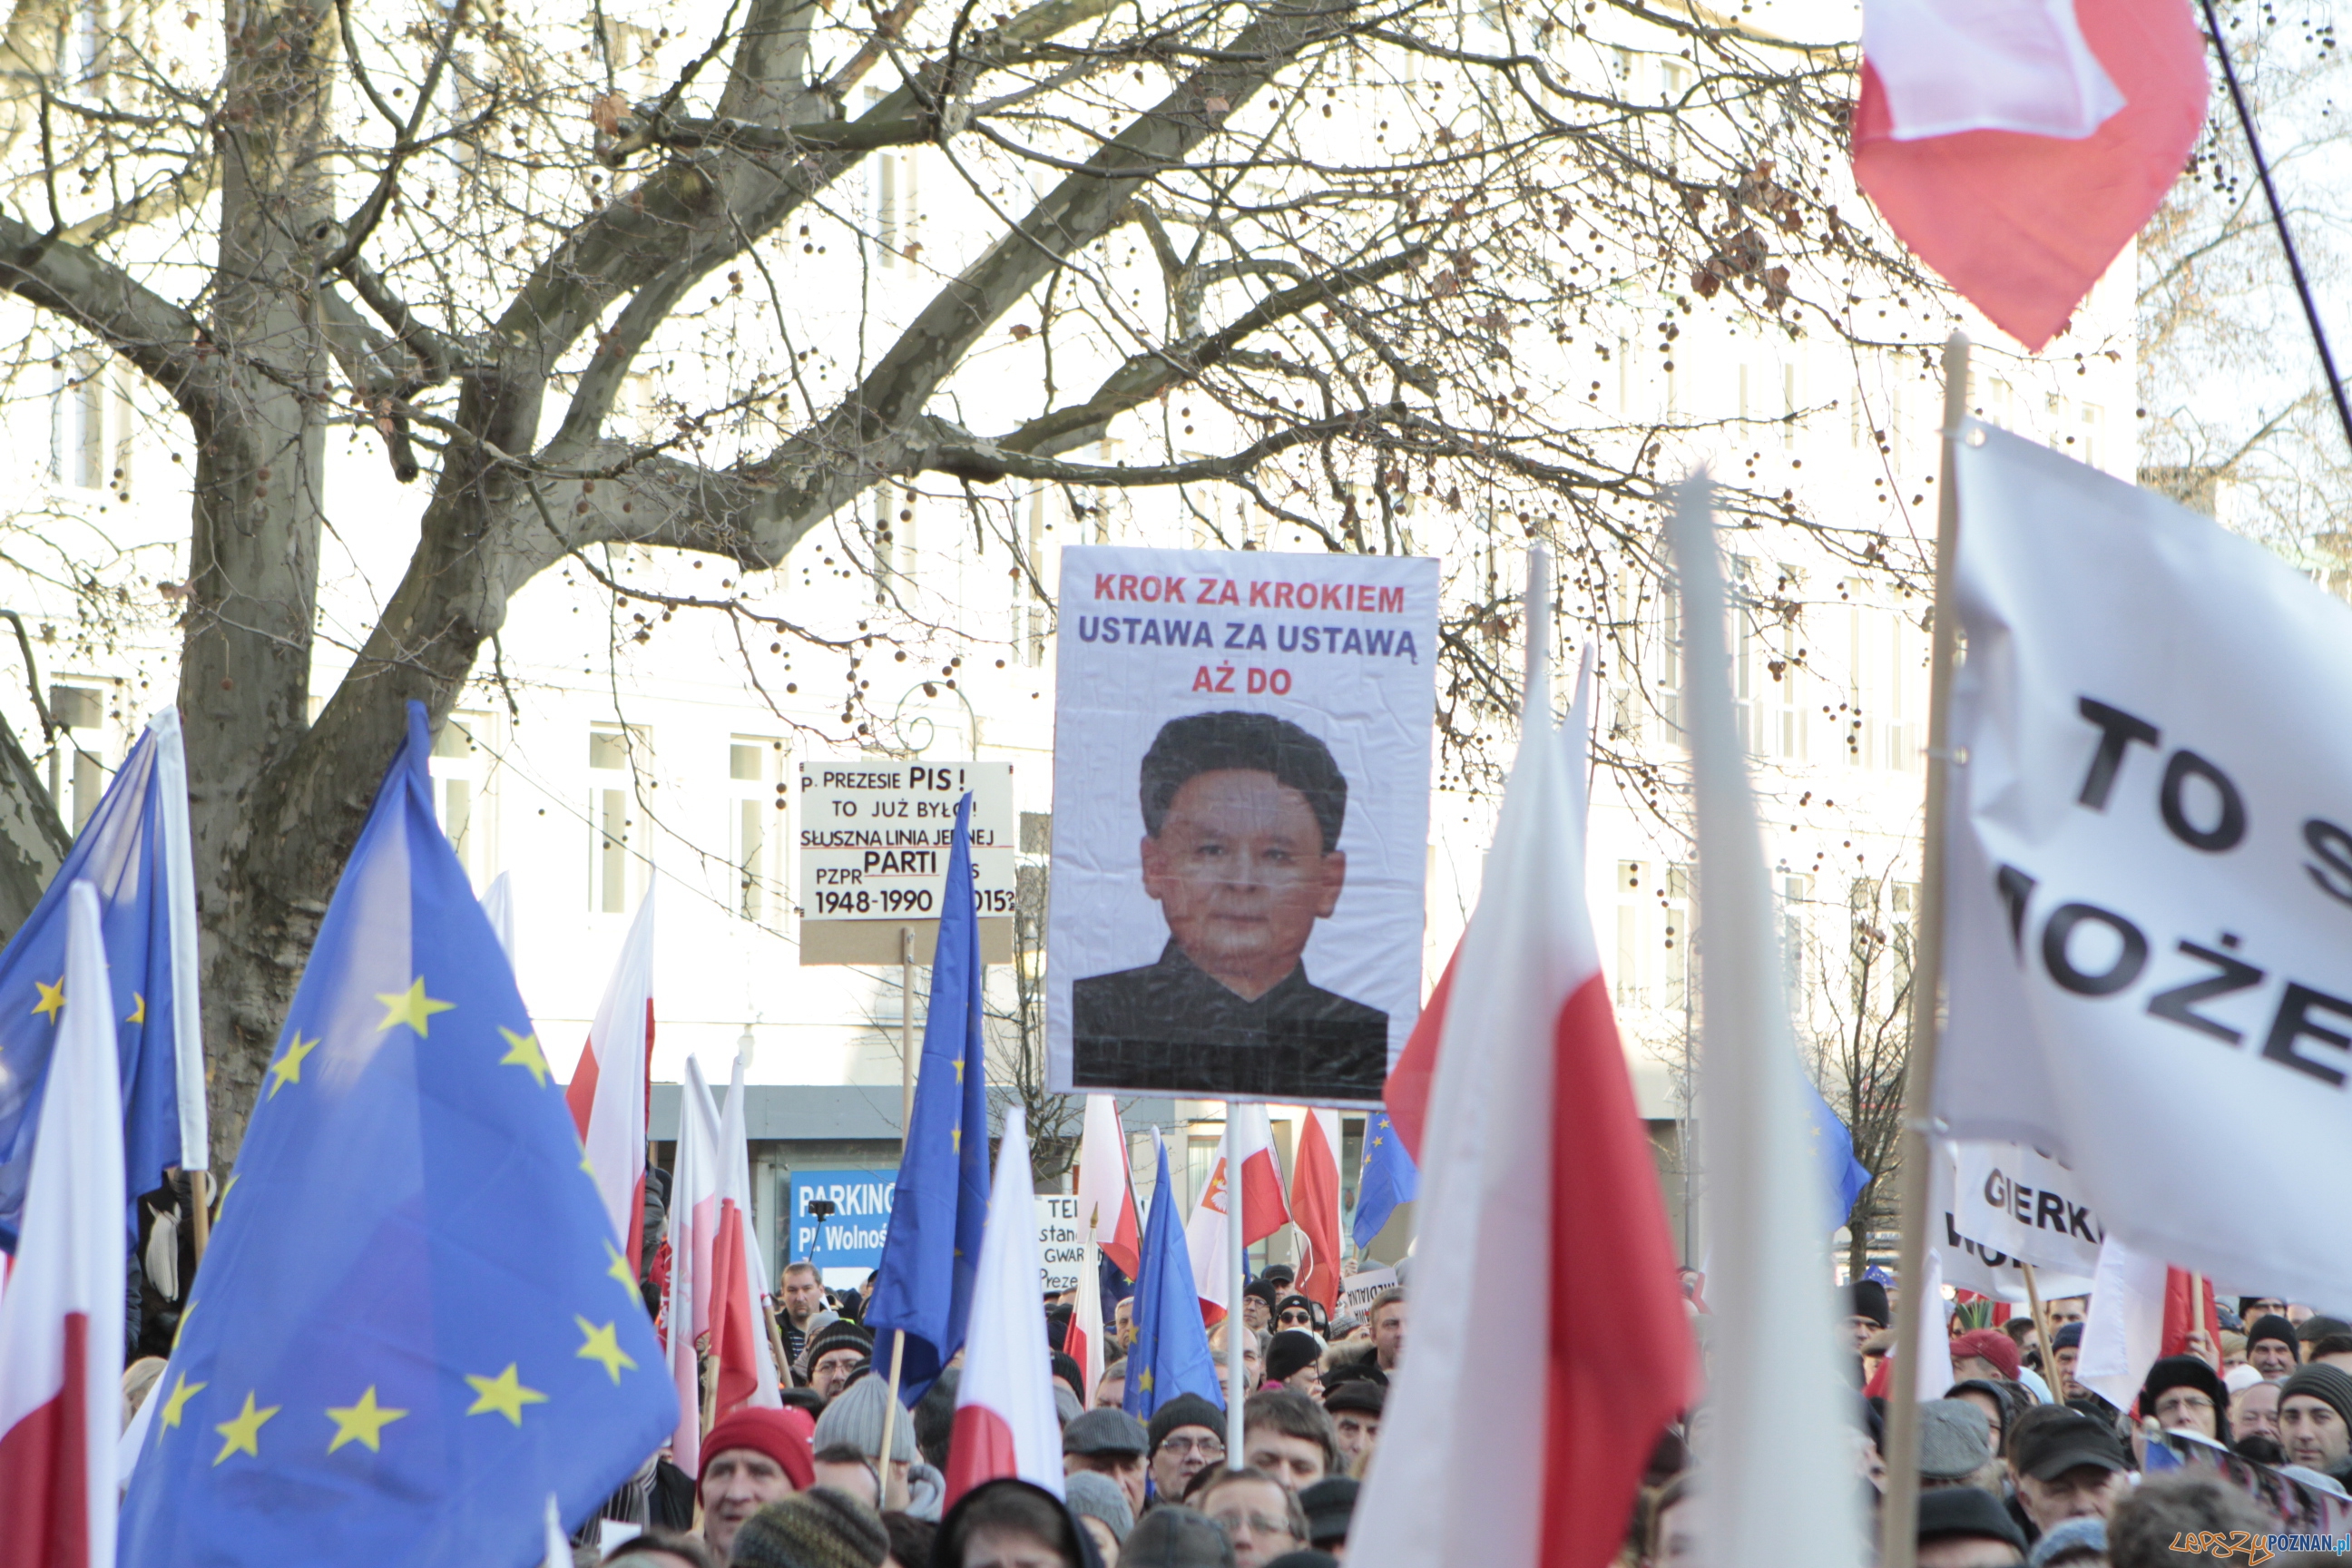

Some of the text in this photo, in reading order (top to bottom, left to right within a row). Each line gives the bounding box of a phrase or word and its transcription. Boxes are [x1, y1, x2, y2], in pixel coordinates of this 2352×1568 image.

[1094, 573, 1405, 613] KROK ZA KROKIEM
[1078, 616, 1417, 665] USTAWA ZA USTAWĄ
[1192, 660, 1291, 696] AŻ DO
[823, 771, 901, 789] PREZESIE
[2077, 695, 2249, 854] TO
[832, 800, 857, 817] TO
[871, 798, 908, 818] JUŻ
[800, 829, 882, 847] SŁUSZNA
[886, 828, 929, 846] LINIA
[864, 850, 936, 874] PARTI
[816, 868, 862, 885] PZPR
[816, 890, 933, 914] 1948-1990
[1984, 1168, 2105, 1245] GIERK
[1039, 1225, 1077, 1242] stan
